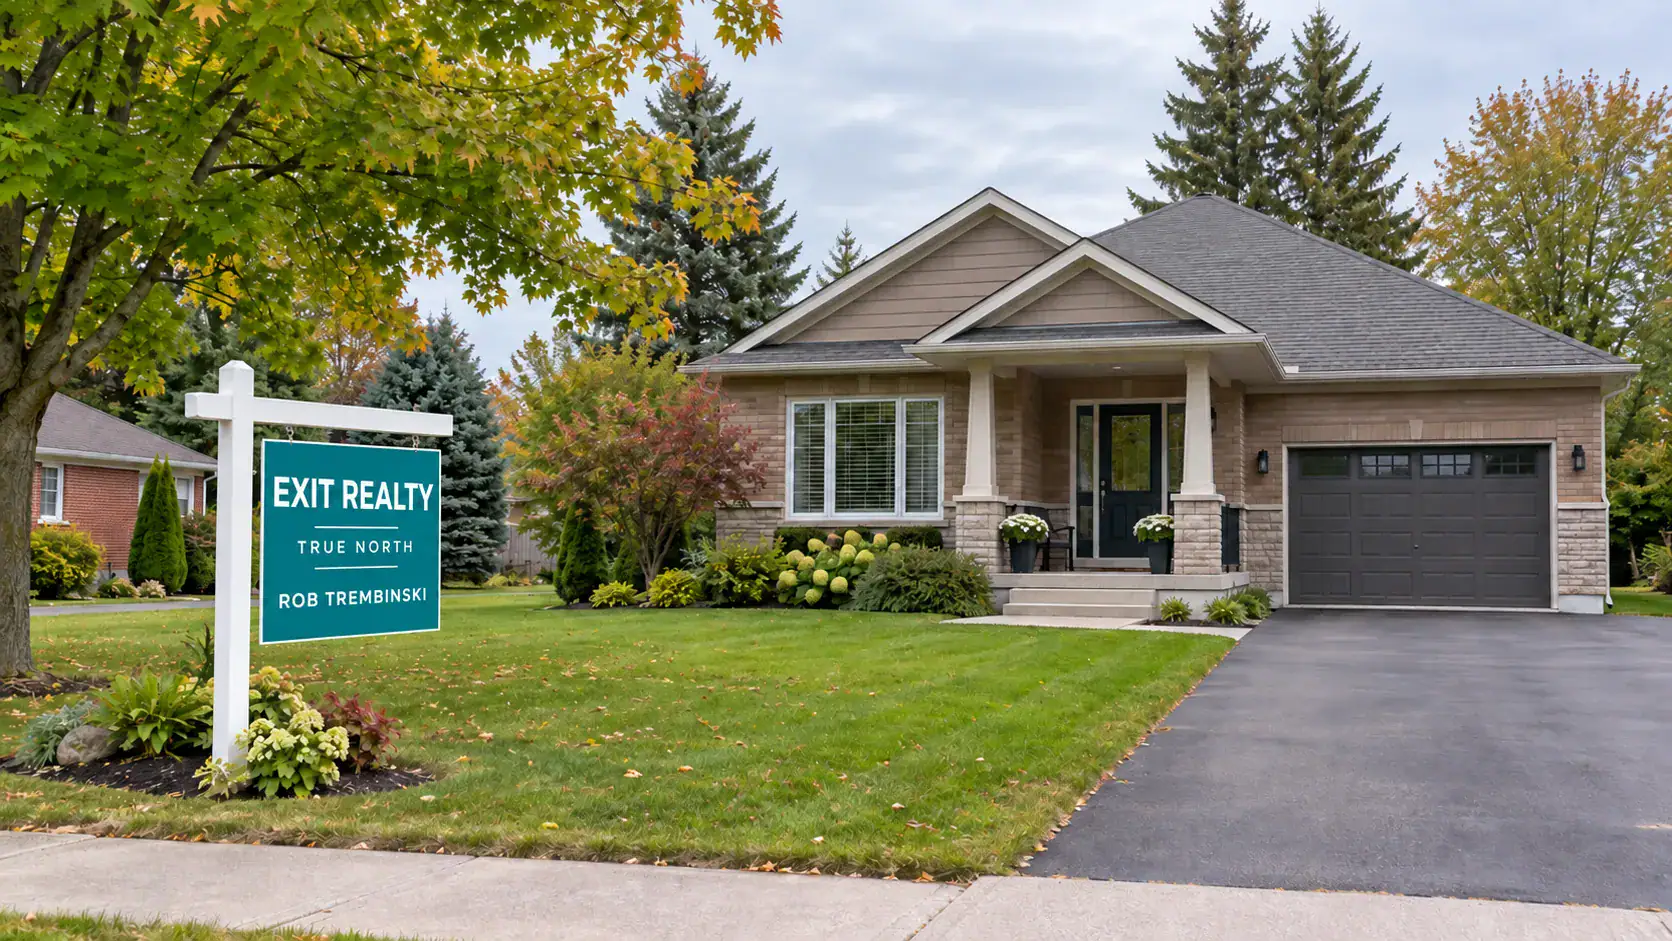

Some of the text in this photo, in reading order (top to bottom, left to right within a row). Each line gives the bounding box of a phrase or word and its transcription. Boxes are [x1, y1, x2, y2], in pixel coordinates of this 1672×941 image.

[274, 476, 433, 511] EXIT REALTY
[298, 541, 412, 554] TRUE NORTH
[279, 588, 426, 608] ROB TREMBINSKI
